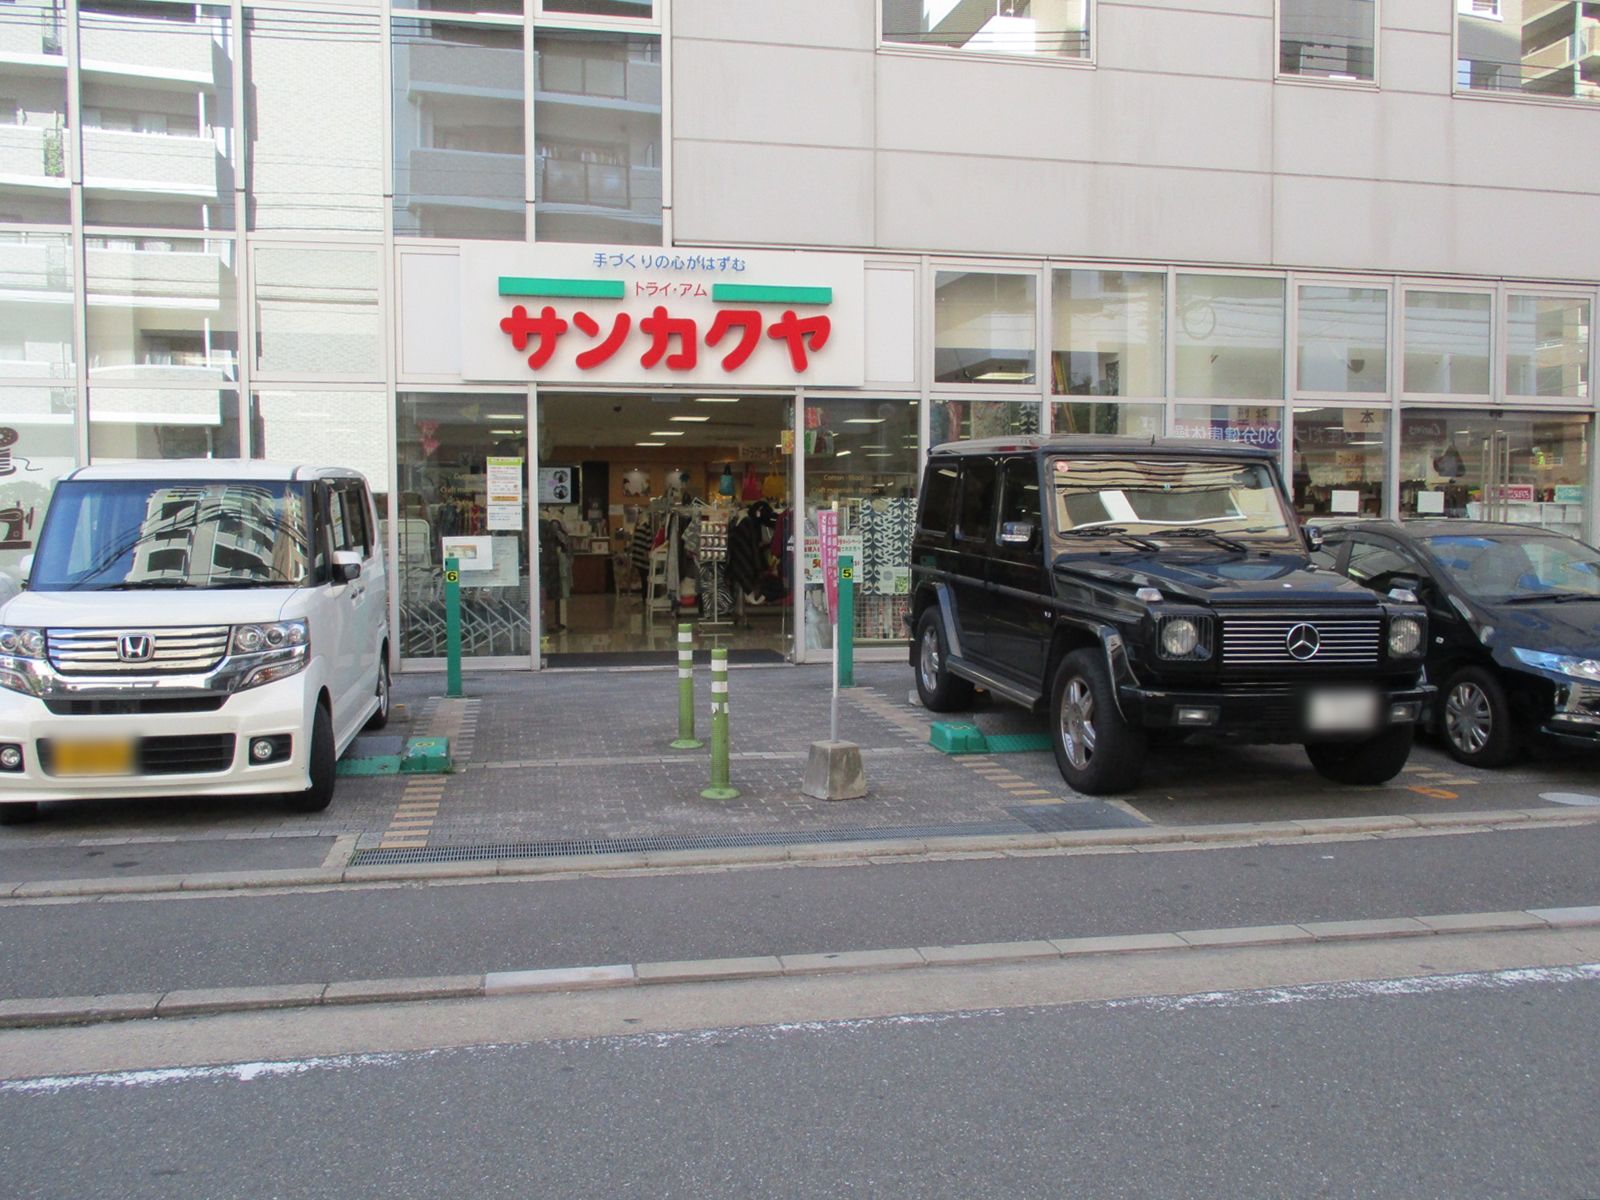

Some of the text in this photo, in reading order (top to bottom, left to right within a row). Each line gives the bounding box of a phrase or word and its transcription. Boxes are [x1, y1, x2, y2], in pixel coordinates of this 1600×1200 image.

[593, 252, 745, 271] 手づくりの心がはずむ
[635, 281, 708, 297] トライ・アム
[500, 304, 832, 373] サンカクヤ
[447, 572, 457, 581] 6
[842, 569, 852, 578] 5
